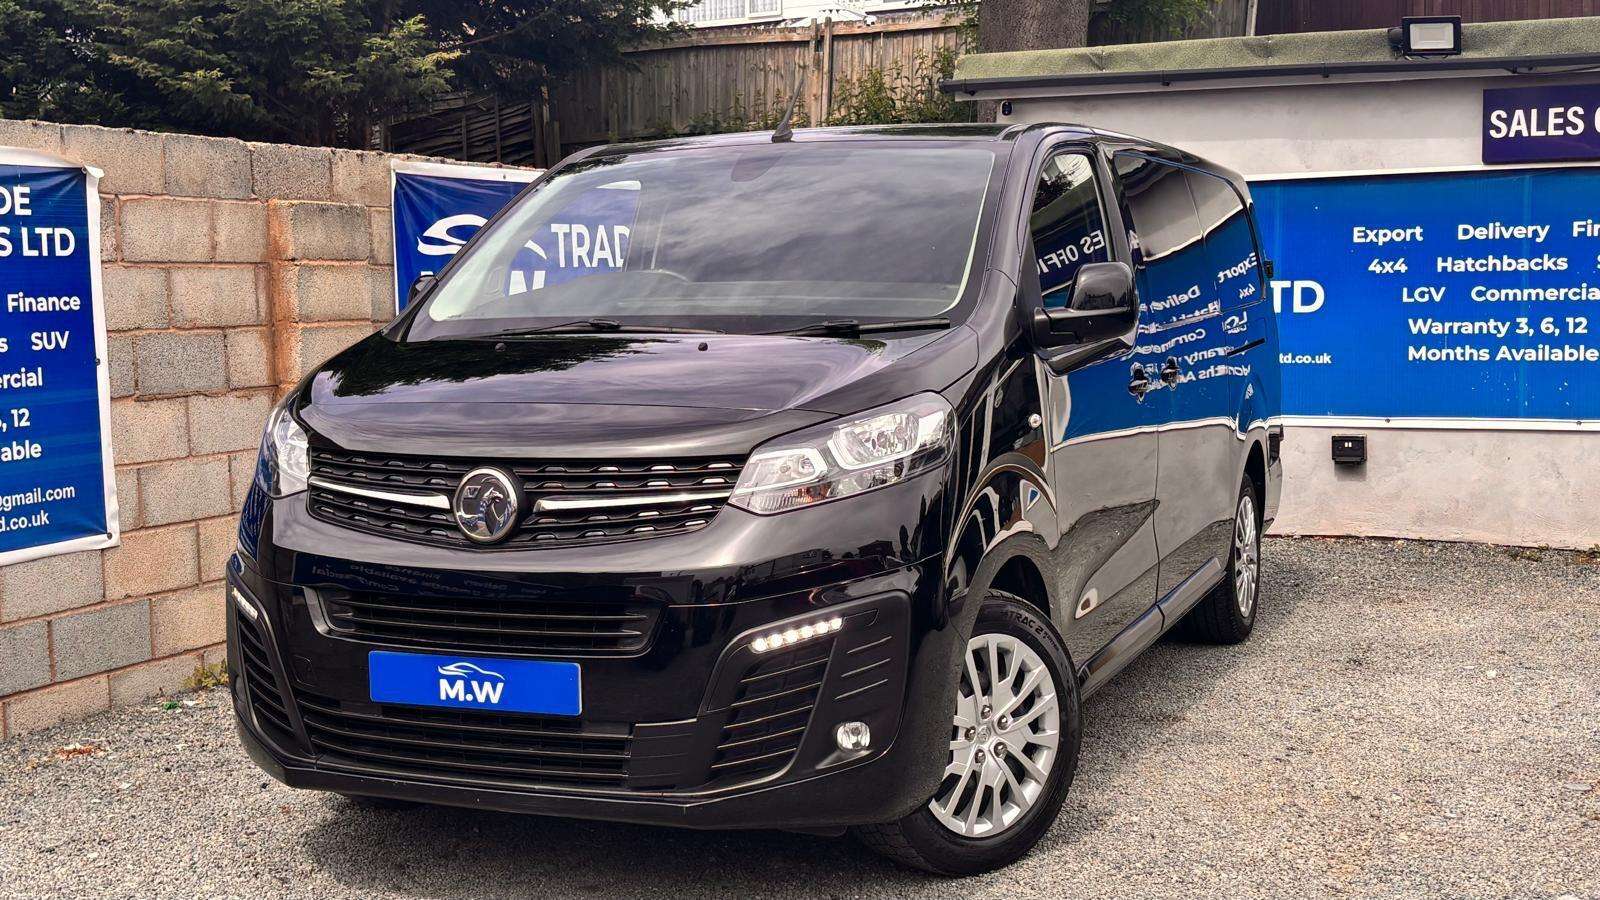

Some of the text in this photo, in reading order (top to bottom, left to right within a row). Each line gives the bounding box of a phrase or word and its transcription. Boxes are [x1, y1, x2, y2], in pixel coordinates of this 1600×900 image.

[1489, 105, 1585, 139] SALES
[21, 227, 76, 257] LTD
[1352, 225, 1424, 246] Export
[1457, 221, 1551, 243] Delivery
[1368, 253, 1569, 274] 4x4 Hatchbacks
[7, 291, 81, 313] Finance
[1402, 282, 1600, 303] LGV Commercia
[1408, 316, 1588, 338] Warranty 3, 6, 12
[31, 330, 70, 351] SUV
[1408, 343, 1600, 362] Months Available
[0, 366, 43, 389] rcial
[10, 407, 31, 428] 12
[1, 439, 42, 462] able
[439, 678, 505, 704] M.W
